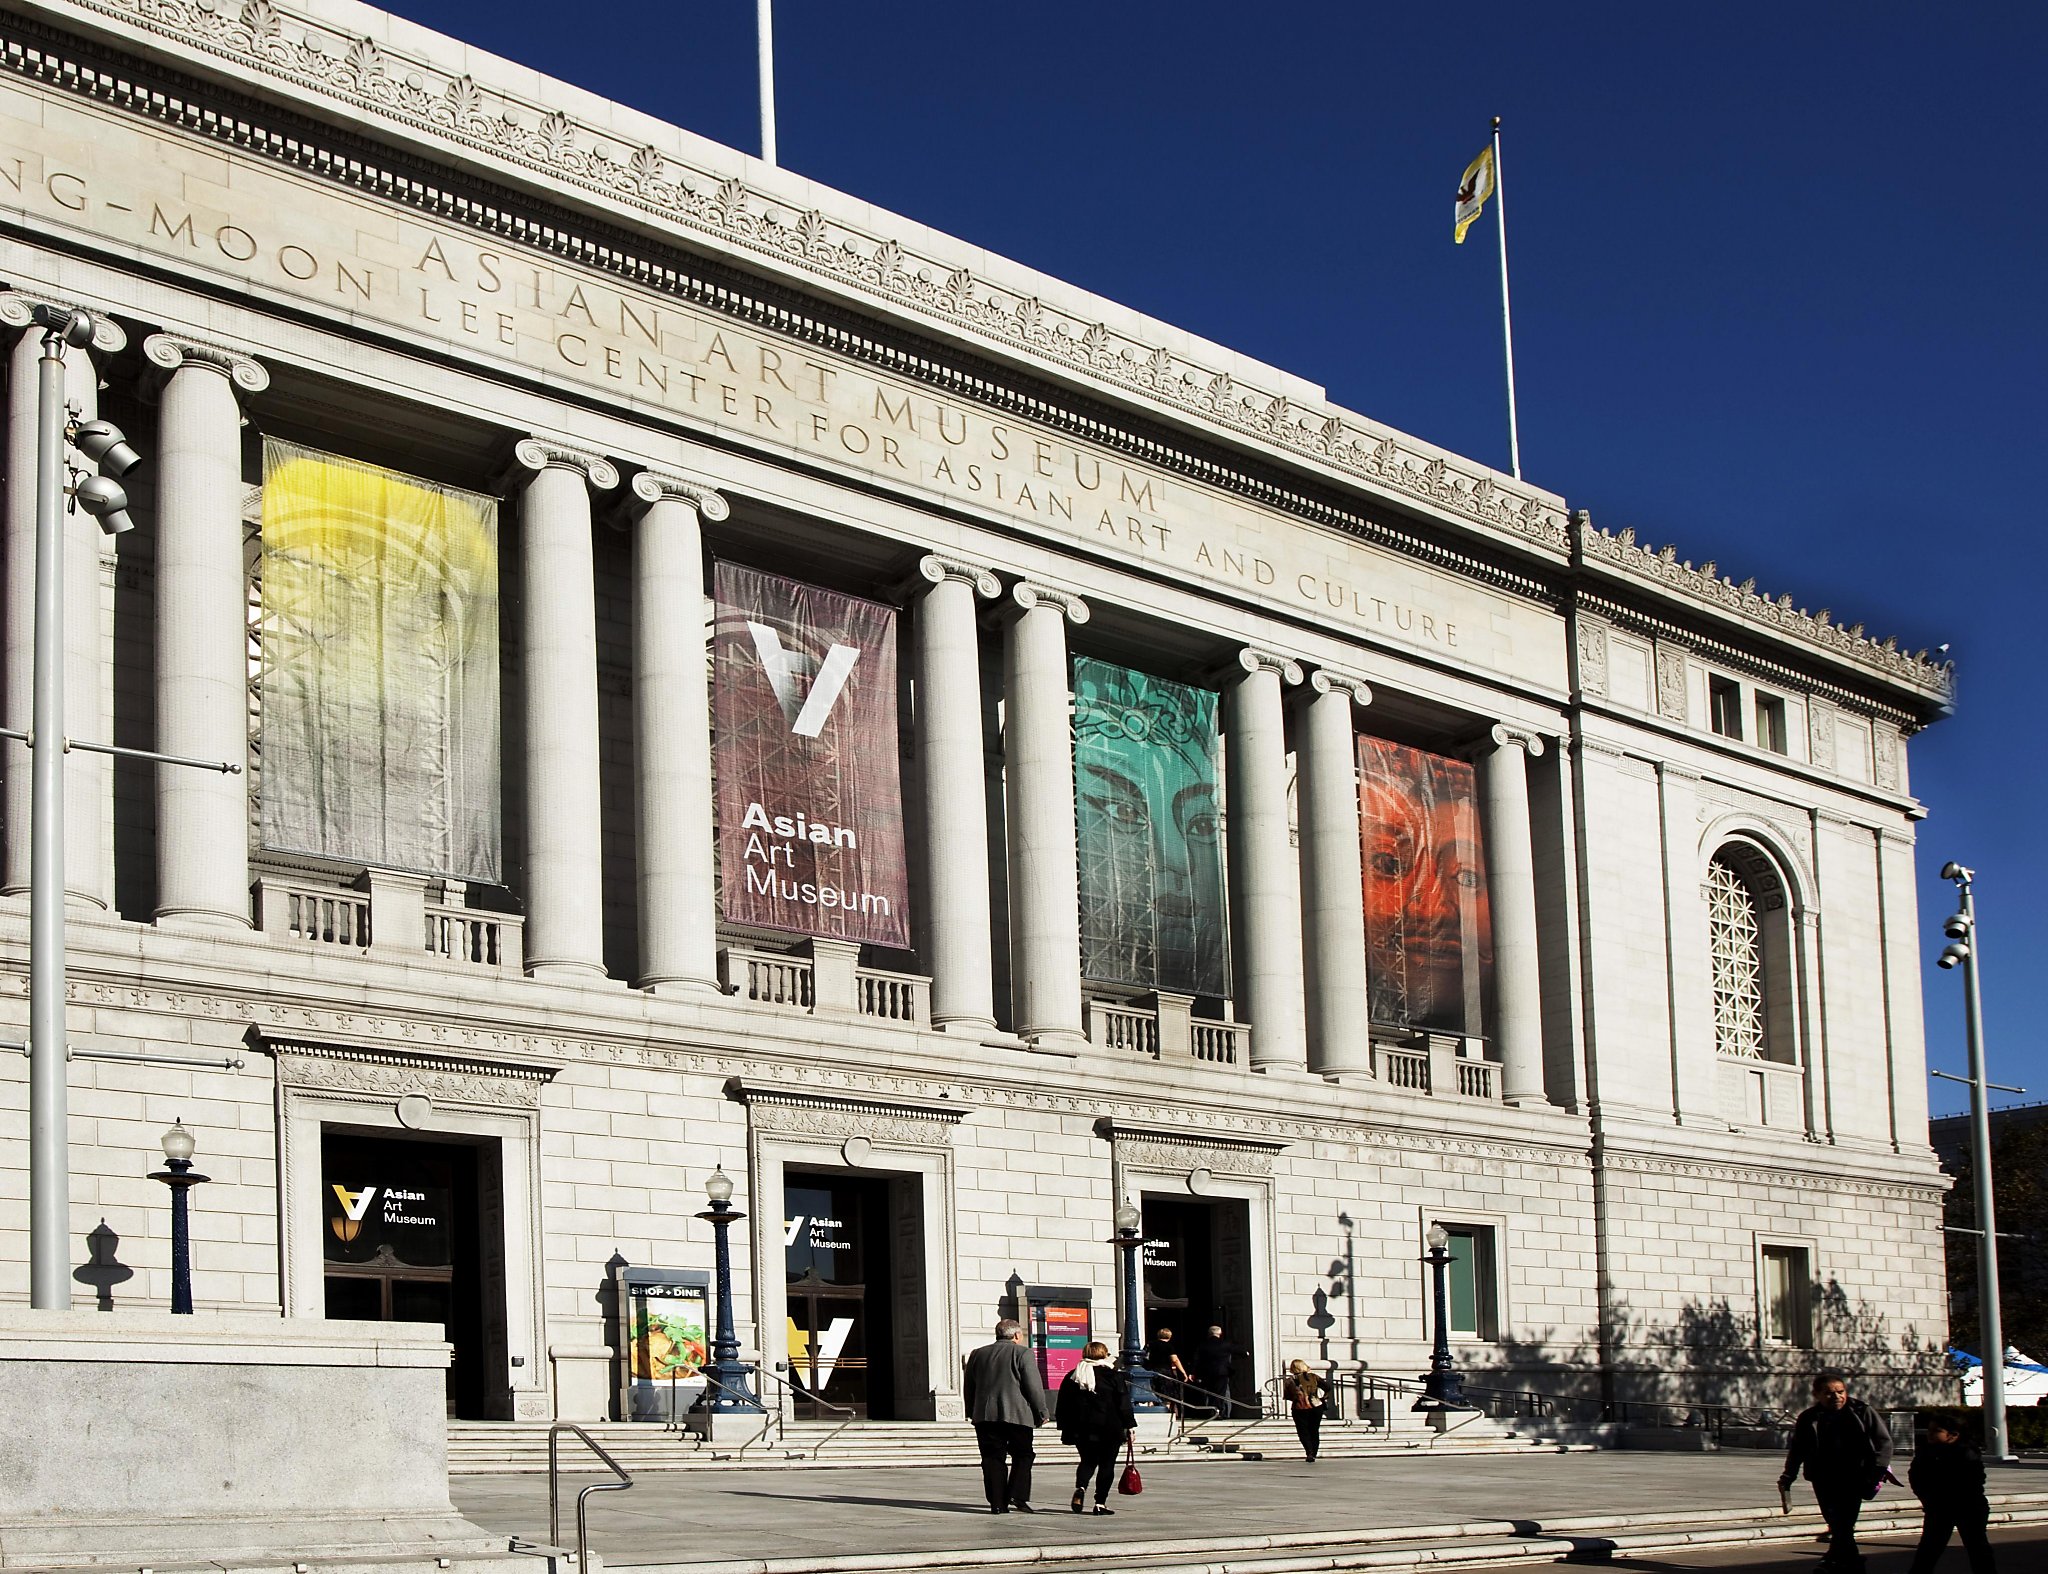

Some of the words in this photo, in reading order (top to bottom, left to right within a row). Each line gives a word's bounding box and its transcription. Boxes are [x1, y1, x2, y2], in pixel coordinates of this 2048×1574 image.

[412, 236, 661, 348] ASIAN
[700, 332, 837, 403] ART
[871, 385, 1156, 513] MUSEUM
[419, 287, 515, 346] LEE
[556, 333, 783, 430] CENTER
[810, 413, 907, 470] FOR
[934, 455, 1073, 522] ASIAN
[1097, 509, 1172, 552] ART
[1195, 541, 1275, 586] AND
[1297, 574, 1458, 647] CULTURE
[742, 803, 856, 850] Asian
[743, 833, 795, 868] Art
[745, 864, 889, 916] Museum
[383, 1188, 425, 1201] Asian
[383, 1201, 403, 1211] Art
[384, 1212, 436, 1226] Museum
[809, 1216, 842, 1228] Asian
[809, 1228, 825, 1238] Art
[810, 1238, 850, 1249] Museum
[1143, 1247, 1156, 1256] Art
[1144, 1257, 1177, 1267] Museum
[631, 1287, 664, 1296] SHOP
[673, 1288, 701, 1297] DINE
